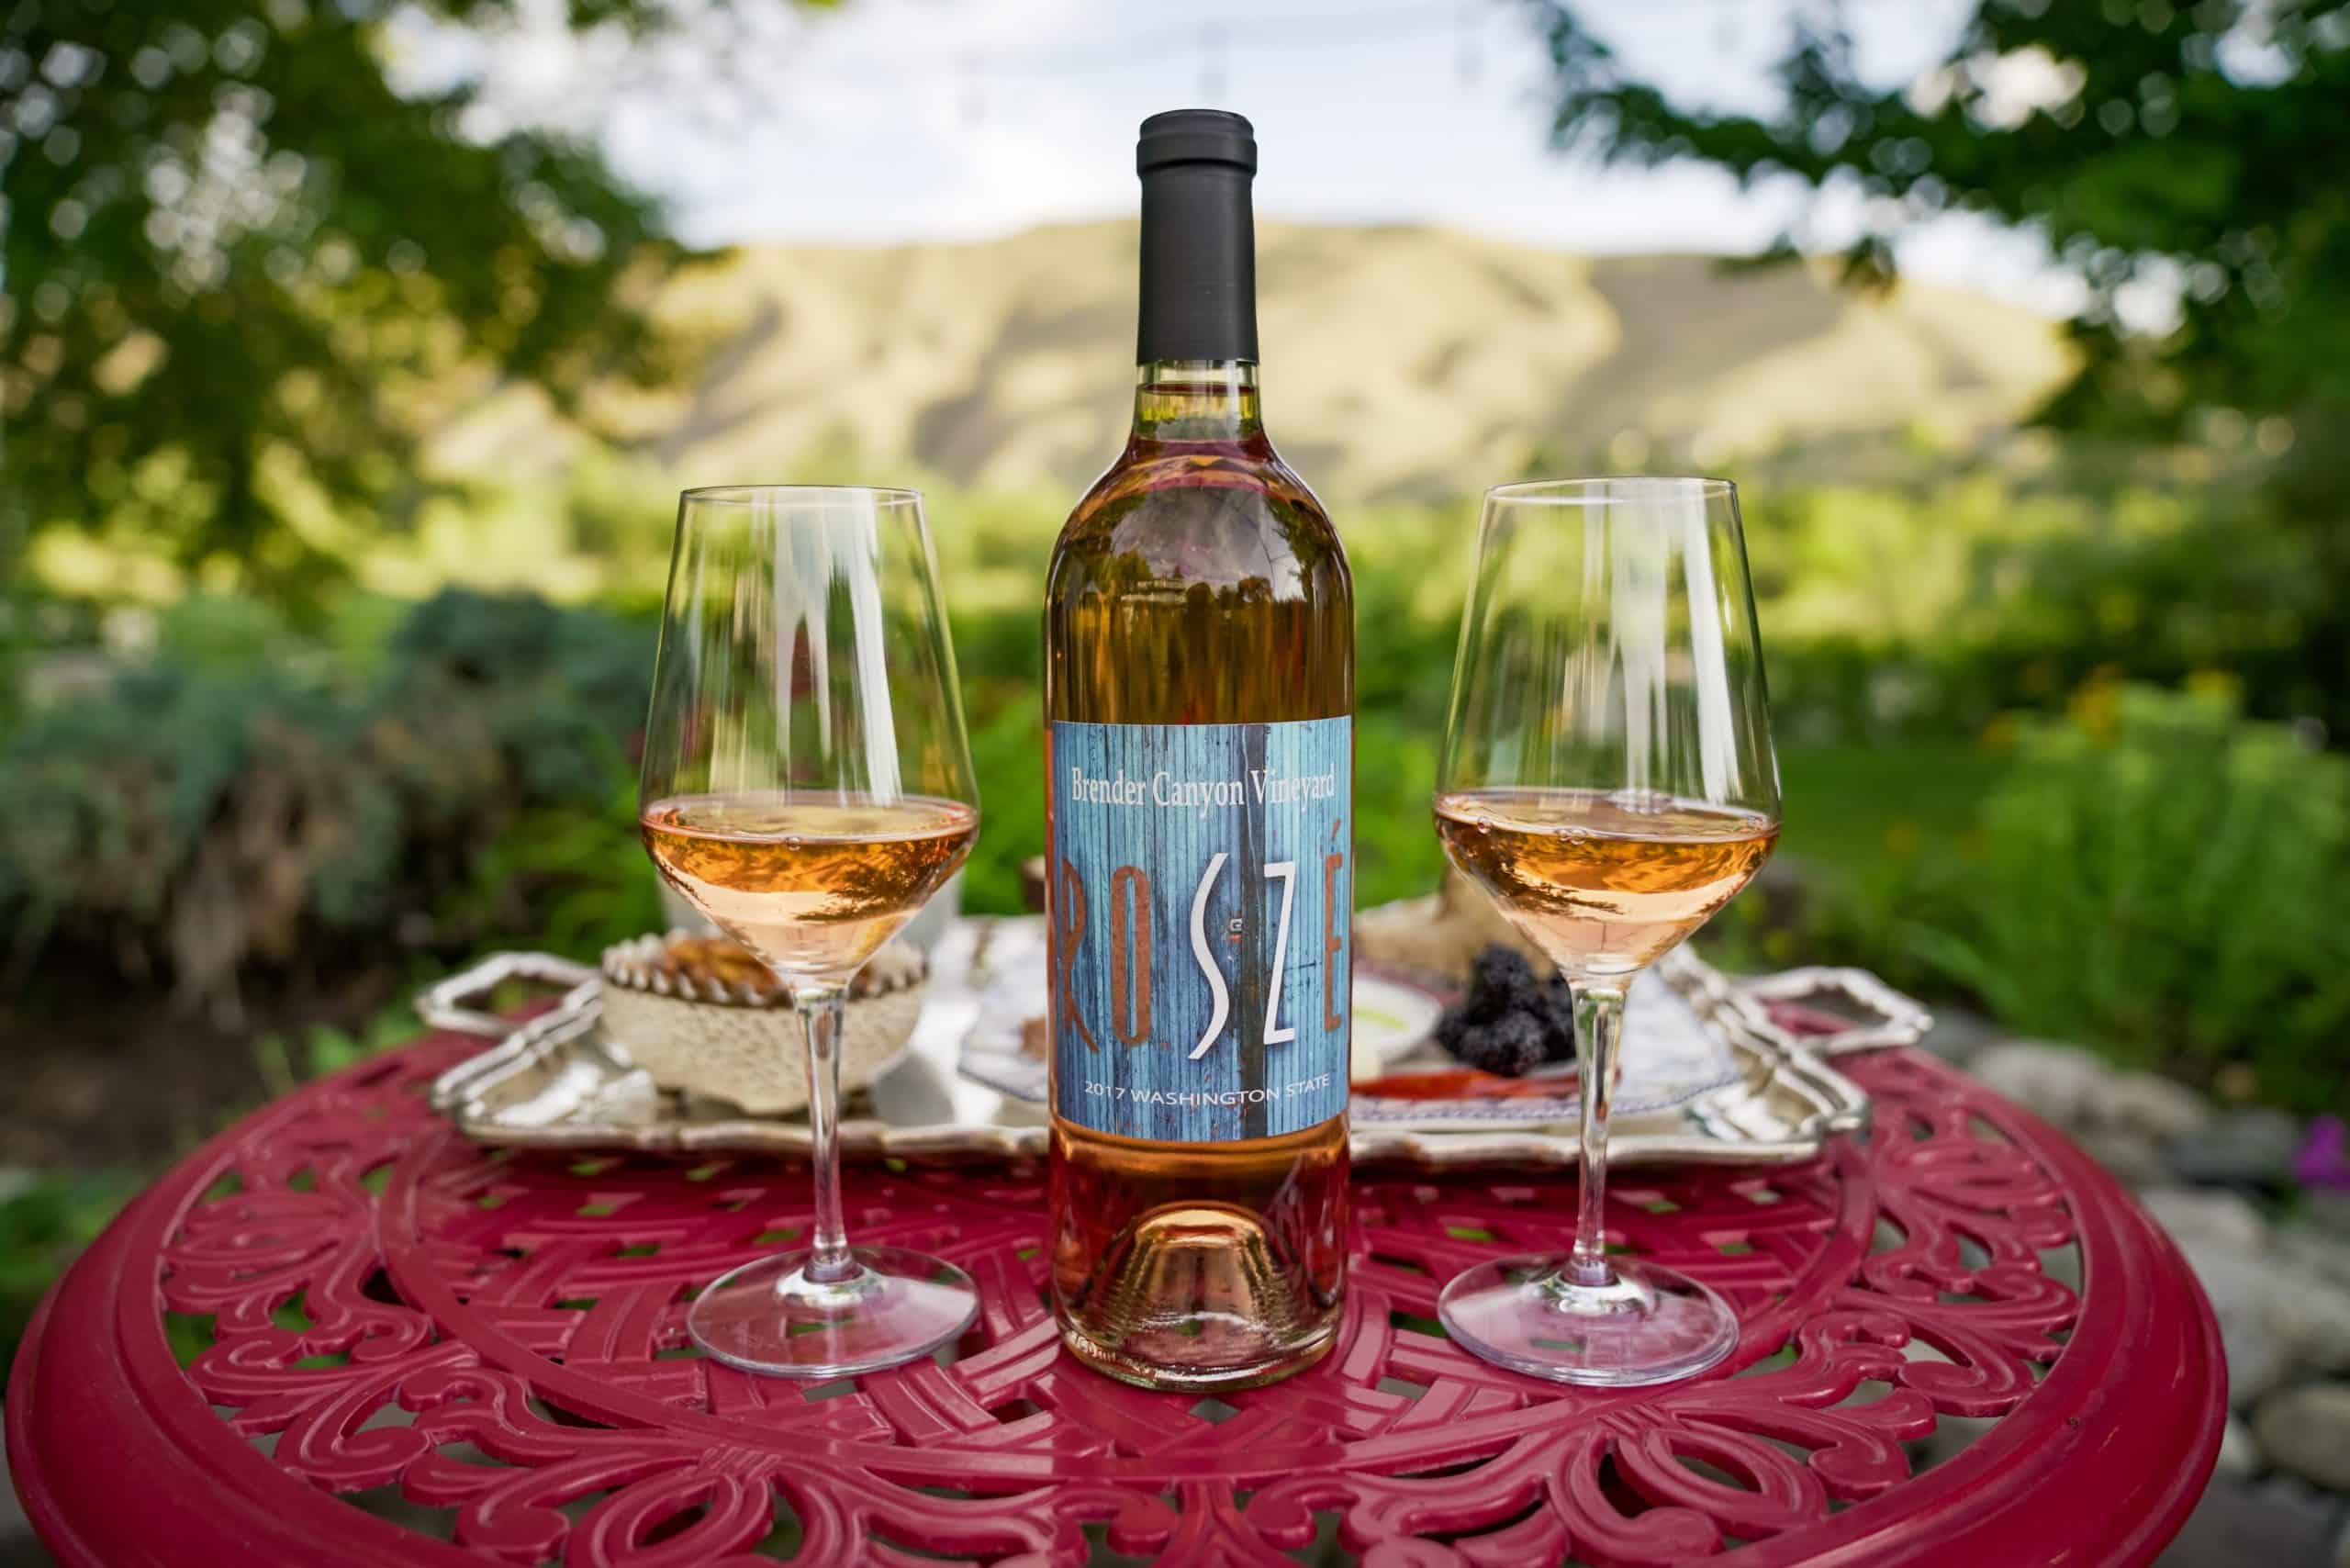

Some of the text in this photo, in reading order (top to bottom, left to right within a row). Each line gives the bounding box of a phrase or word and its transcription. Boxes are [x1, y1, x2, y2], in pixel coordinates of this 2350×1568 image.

[1071, 764, 1336, 818] Brender Canyon Vineyard
[1084, 1072, 1330, 1107] 2017 WASHINGTON STATE
